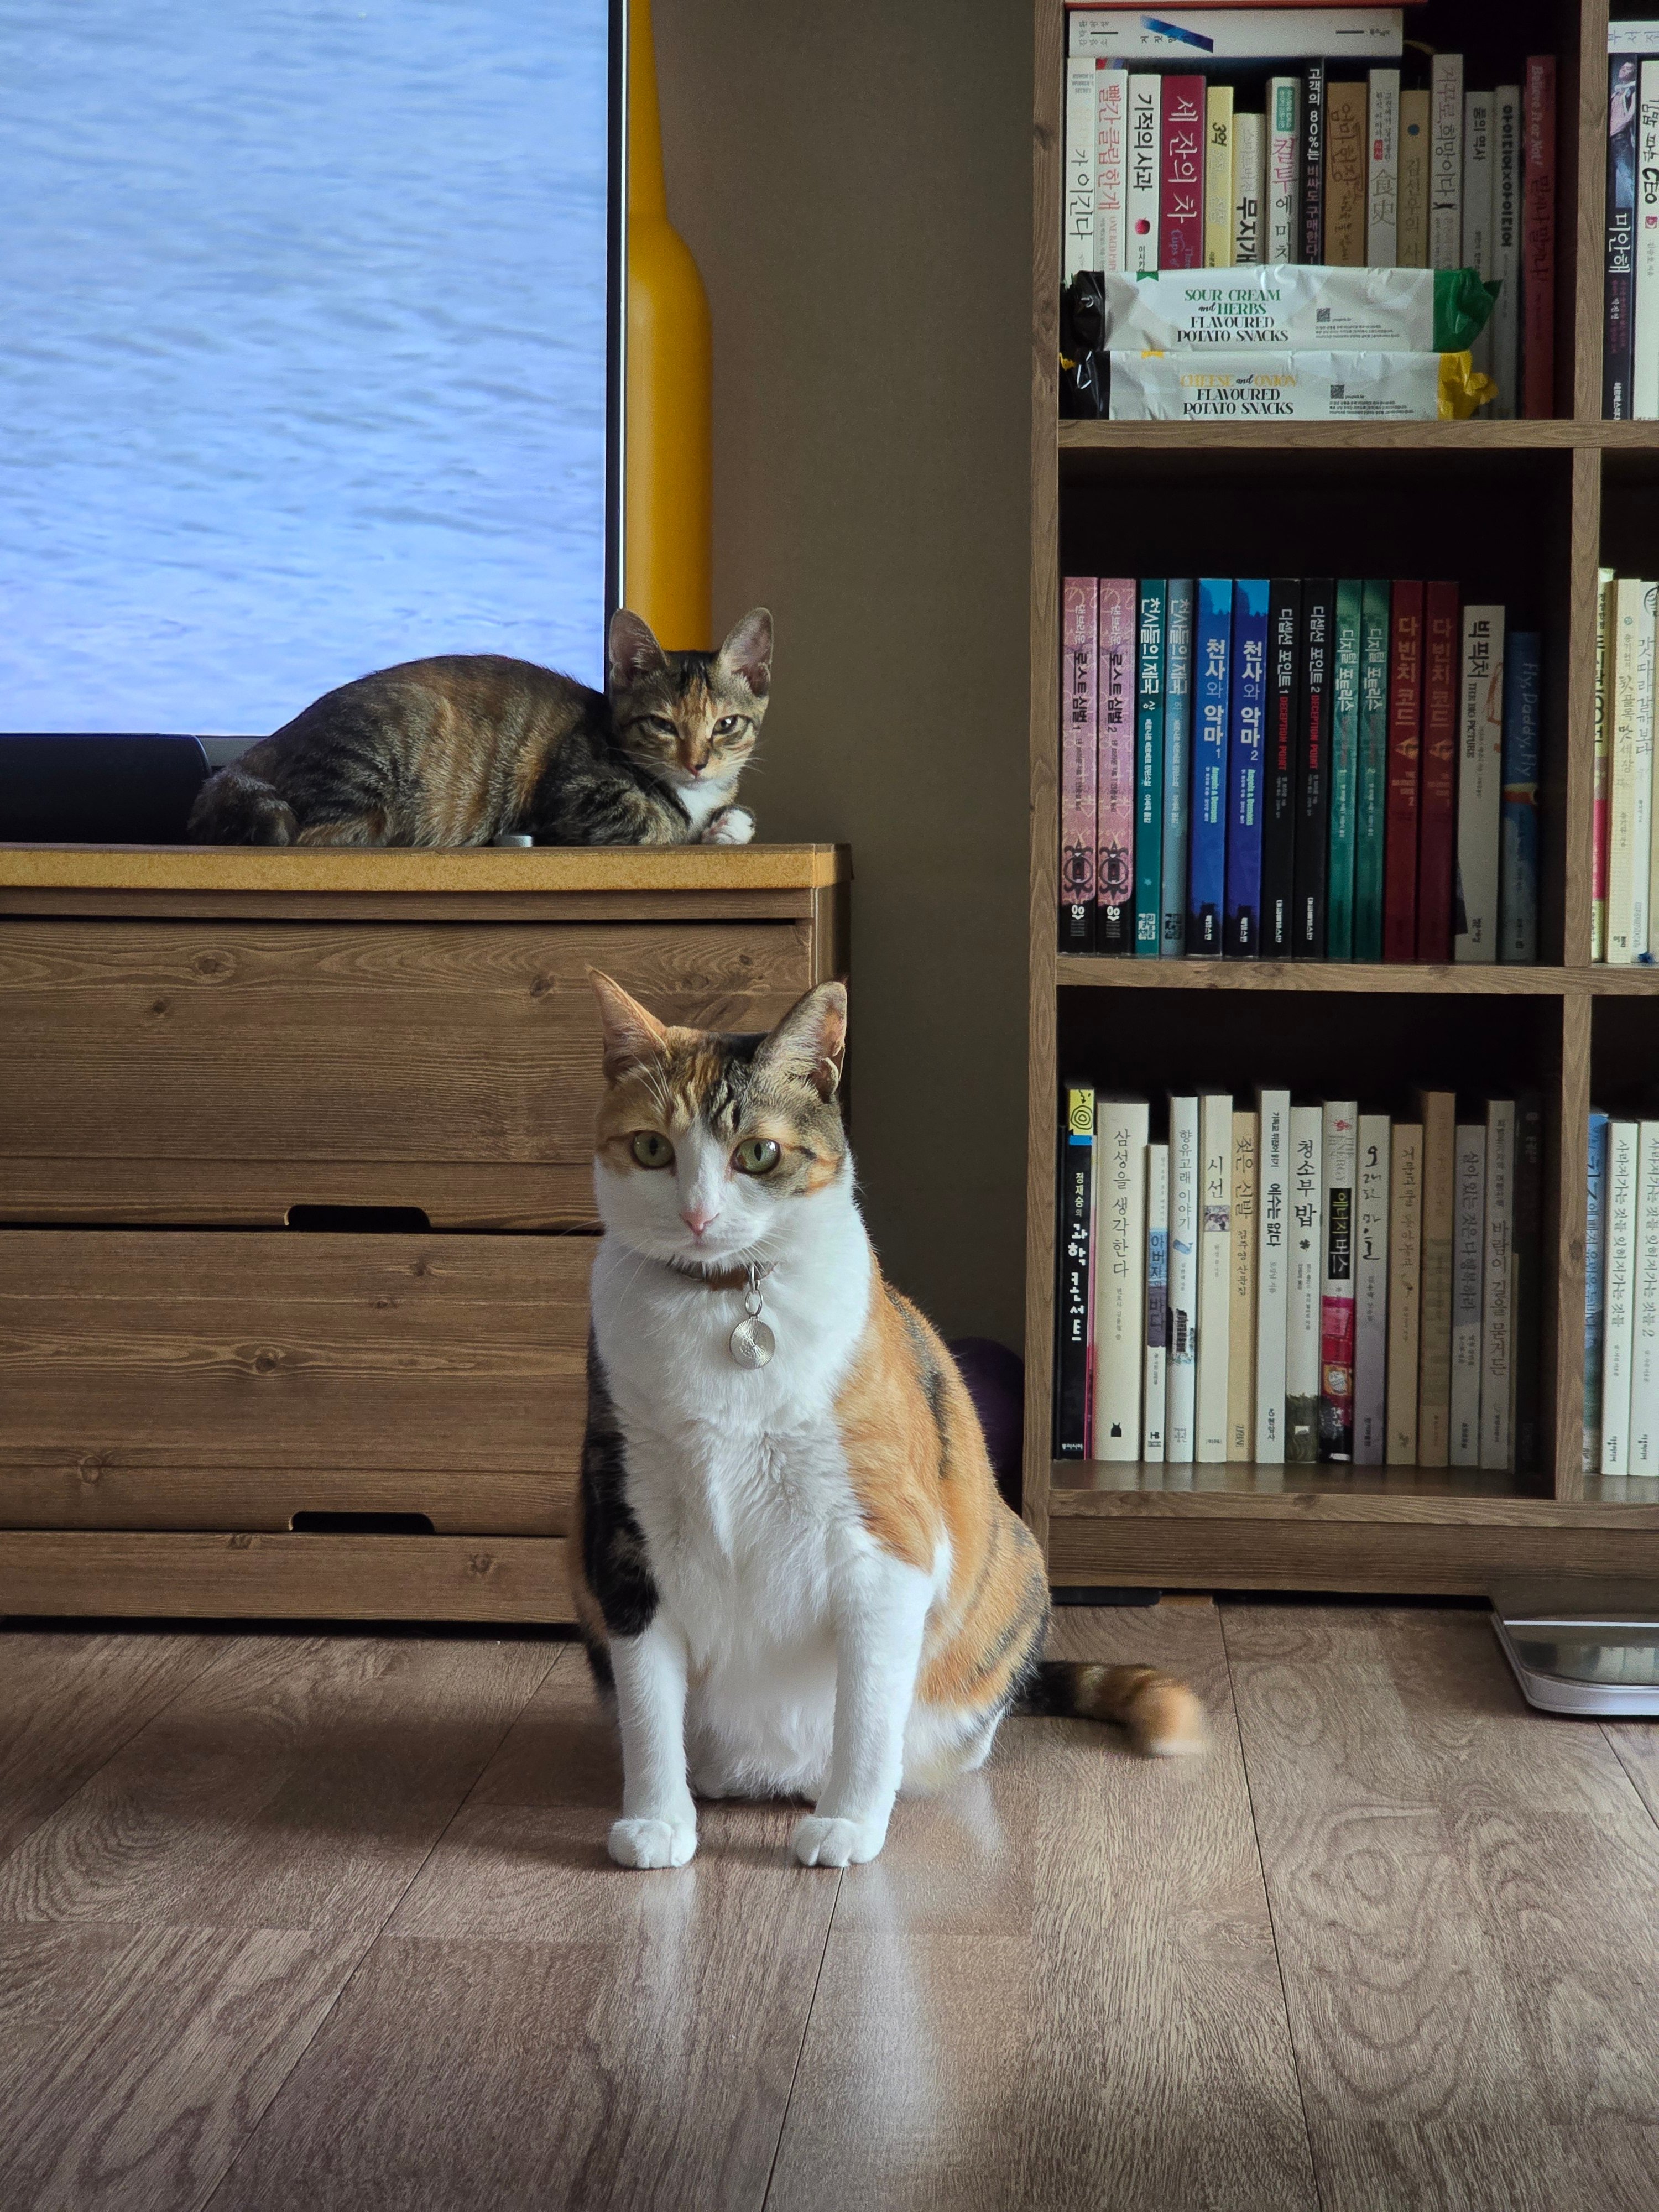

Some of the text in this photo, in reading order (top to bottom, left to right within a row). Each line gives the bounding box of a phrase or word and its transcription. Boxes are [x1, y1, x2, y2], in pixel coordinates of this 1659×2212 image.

[1099, 85, 1121, 124] 빨간
[1308, 69, 1321, 106] 고객의
[1098, 127, 1120, 165] 클립
[1134, 94, 1154, 191] 기적의 사과
[1211, 123, 1227, 146] 3억
[1307, 110, 1321, 161] 80%는
[1167, 96, 1198, 223] 세 잔의 차
[1435, 124, 1455, 195] 희망이다
[1070, 174, 1093, 240] 이긴다
[1236, 197, 1258, 262] 무지개
[1608, 213, 1631, 273] 미안해
[1185, 289, 1281, 301] SOUR CREAM
[1198, 302, 1266, 315] and HERBS
[1177, 330, 1289, 342] POTATO SNACKS
[1191, 316, 1274, 328] FLAVOURED
[1180, 374, 1299, 387] CHEESE and ONION
[1197, 388, 1280, 401] FLAVOURED
[1183, 402, 1294, 415] POTATO SNACKS
[1170, 599, 1189, 660] 천사들의
[1278, 608, 1293, 645] 디셉션
[1310, 606, 1325, 643] 디셉션
[1432, 617, 1453, 638] 다
[1140, 598, 1160, 710] 천사들의 제국 상
[1337, 630, 1357, 664] 디지털
[1365, 628, 1386, 662] 디지털
[1467, 620, 1490, 678] 빅 픽처
[1074, 652, 1087, 695] 로스트
[1109, 653, 1122, 696] 로스트
[1170, 664, 1188, 695] 제국
[1277, 650, 1292, 687] 포인트
[1309, 648, 1323, 685] 포인트
[1394, 616, 1420, 726] 다 빈치 코드
[1204, 638, 1226, 758] 천사와 악마 1
[1240, 640, 1263, 761] 천사와 악마 2
[1336, 667, 1354, 712] 포트리스
[1364, 666, 1382, 711] 포트리스
[1072, 696, 1087, 723] 심벌
[1108, 697, 1122, 724] 심벌
[1279, 696, 1288, 742] DECEPTION
[1310, 695, 1319, 741] DECEPTION
[1429, 690, 1450, 728] 코드
[1467, 682, 1477, 758] THE BIG PICTURE
[1515, 662, 1538, 777] Fly, Daddy, Fly
[1278, 745, 1287, 771] POINT
[1309, 744, 1318, 769] POINT
[1408, 796, 1415, 807] 2
[1271, 1112, 1279, 1131] 기독교
[1178, 1129, 1193, 1230] 향유고래 이야기
[1207, 1155, 1224, 1199] 시선
[1294, 1139, 1317, 1228] 청소부 밥
[1462, 1182, 1478, 1209] 있는
[1112, 1128, 1131, 1279] 삼성을 생각한다
[1266, 1183, 1281, 1247] 예수는 없다
[1329, 1192, 1349, 1274] 에너지 버스
[1462, 1212, 1478, 1238] 것은
[1067, 1172, 1088, 1341] 정재승의 과학 콘서트
[1642, 1329, 1655, 1337] 2
